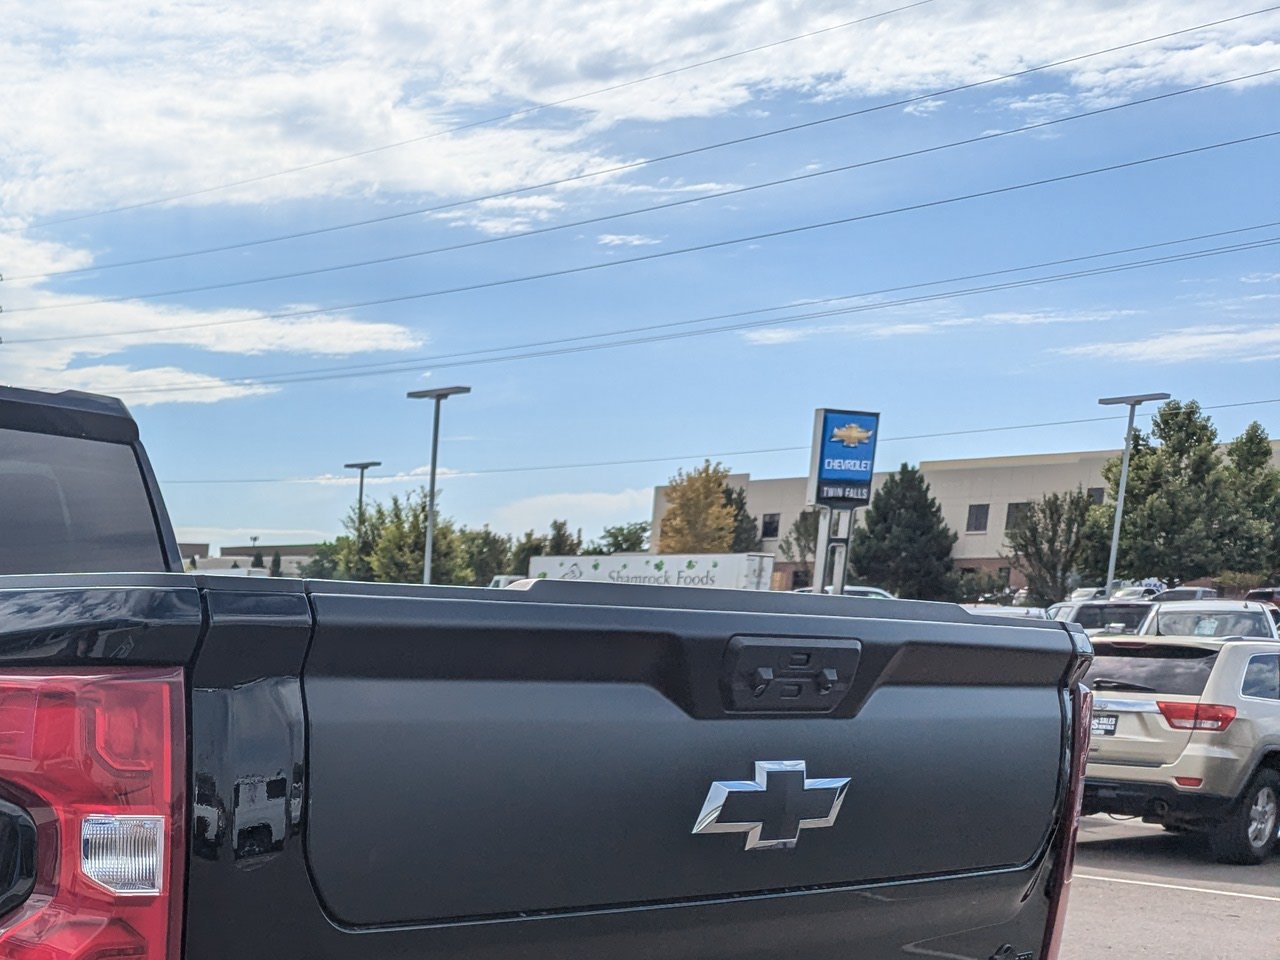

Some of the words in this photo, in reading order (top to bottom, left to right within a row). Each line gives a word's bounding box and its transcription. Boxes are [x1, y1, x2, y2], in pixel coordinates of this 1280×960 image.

[824, 458, 871, 471] CHEVROLET
[823, 486, 843, 497] TWIN
[845, 487, 868, 498] FALLS
[608, 569, 670, 585] Shamrock
[676, 570, 716, 586] Foods
